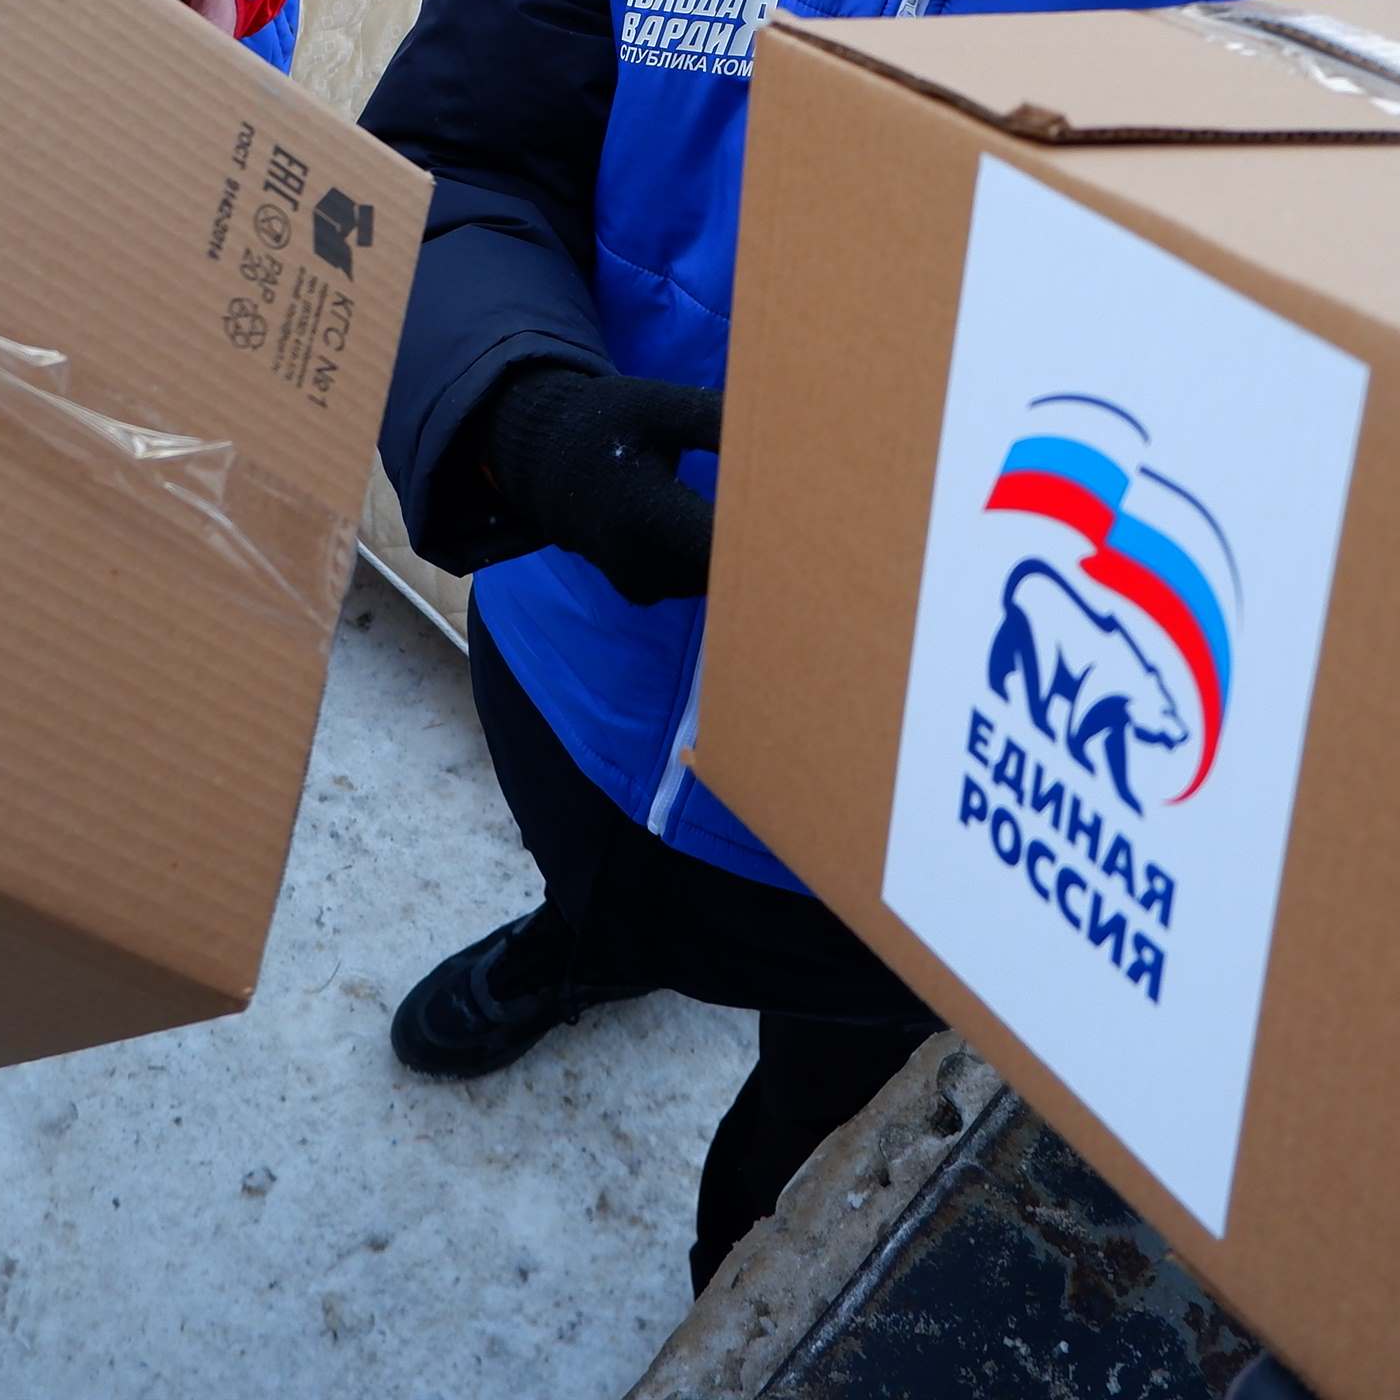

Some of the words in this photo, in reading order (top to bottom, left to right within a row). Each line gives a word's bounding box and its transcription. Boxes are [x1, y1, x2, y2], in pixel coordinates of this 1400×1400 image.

[620, 44, 707, 73] СПУБЛИКА
[711, 57, 755, 77] КОМ
[231, 121, 256, 170] ГОСТ
[239, 248, 263, 282] 20
[260, 254, 284, 304] PAP
[323, 290, 354, 352] КГС
[967, 705, 1176, 930] ЕДИНАЯ
[959, 773, 1166, 1005] РОССИЯ
